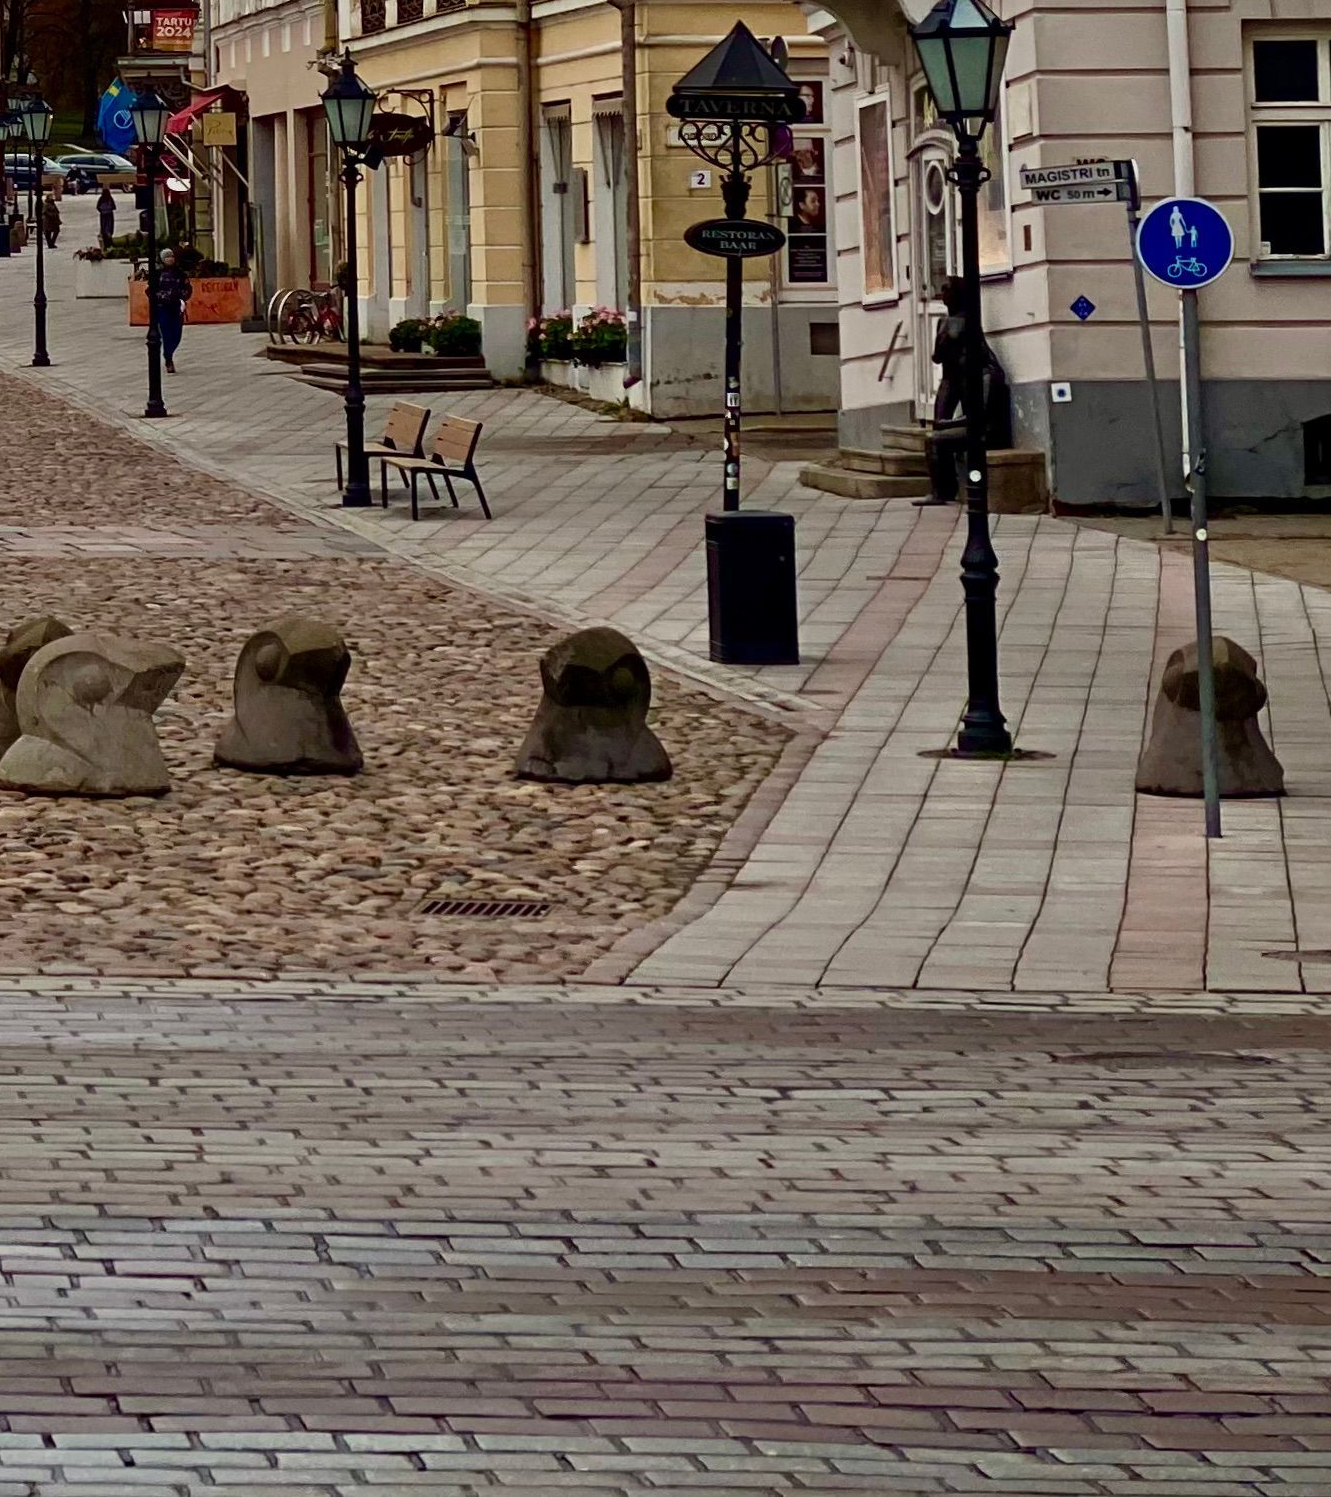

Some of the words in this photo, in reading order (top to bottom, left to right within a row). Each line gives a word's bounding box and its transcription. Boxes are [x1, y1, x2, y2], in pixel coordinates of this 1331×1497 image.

[155, 17, 192, 27] TARTU
[156, 26, 192, 38] 2024
[679, 99, 794, 116] TAVERNA
[697, 172, 706, 186] 2
[1024, 167, 1093, 185] MAGISTRI
[1096, 167, 1111, 178] tn
[1035, 189, 1061, 201] WC
[1067, 191, 1080, 200] 50
[1082, 190, 1096, 200] m
[701, 229, 776, 240] RESTORAN
[719, 240, 757, 250] BAAR
